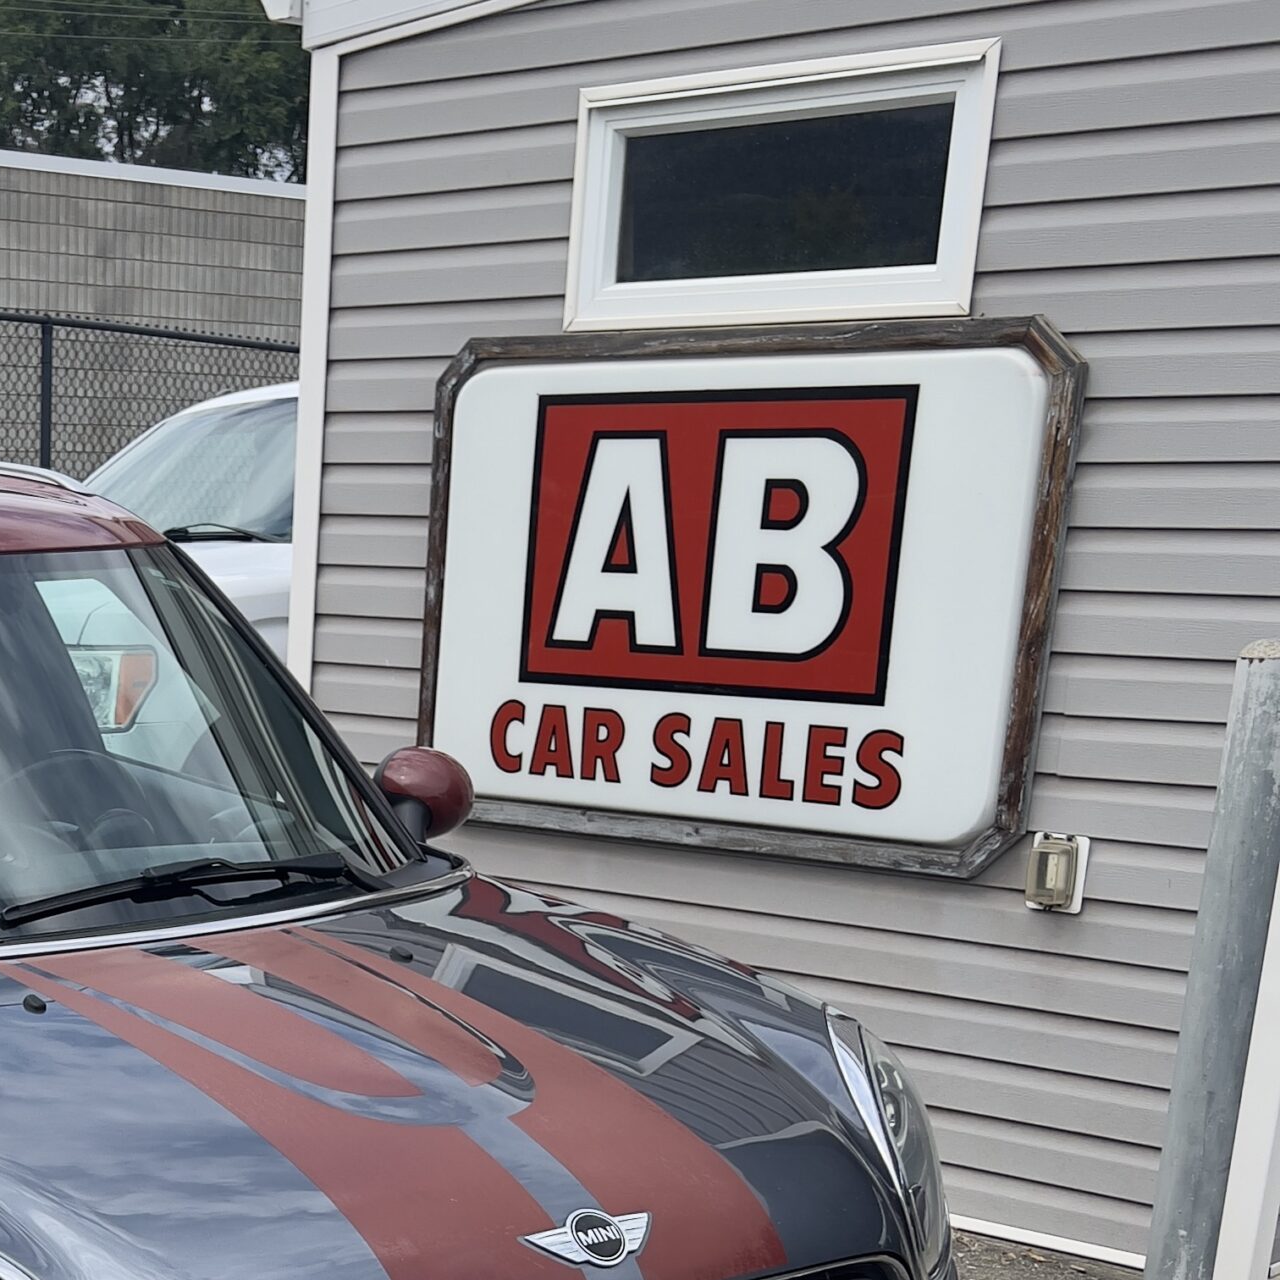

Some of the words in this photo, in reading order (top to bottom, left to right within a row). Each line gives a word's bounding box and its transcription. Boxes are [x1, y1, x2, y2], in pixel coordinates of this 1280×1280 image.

[545, 427, 868, 662] AB
[489, 698, 626, 784] CAR
[650, 712, 905, 811] SALES
[576, 1225, 621, 1247] MINI
